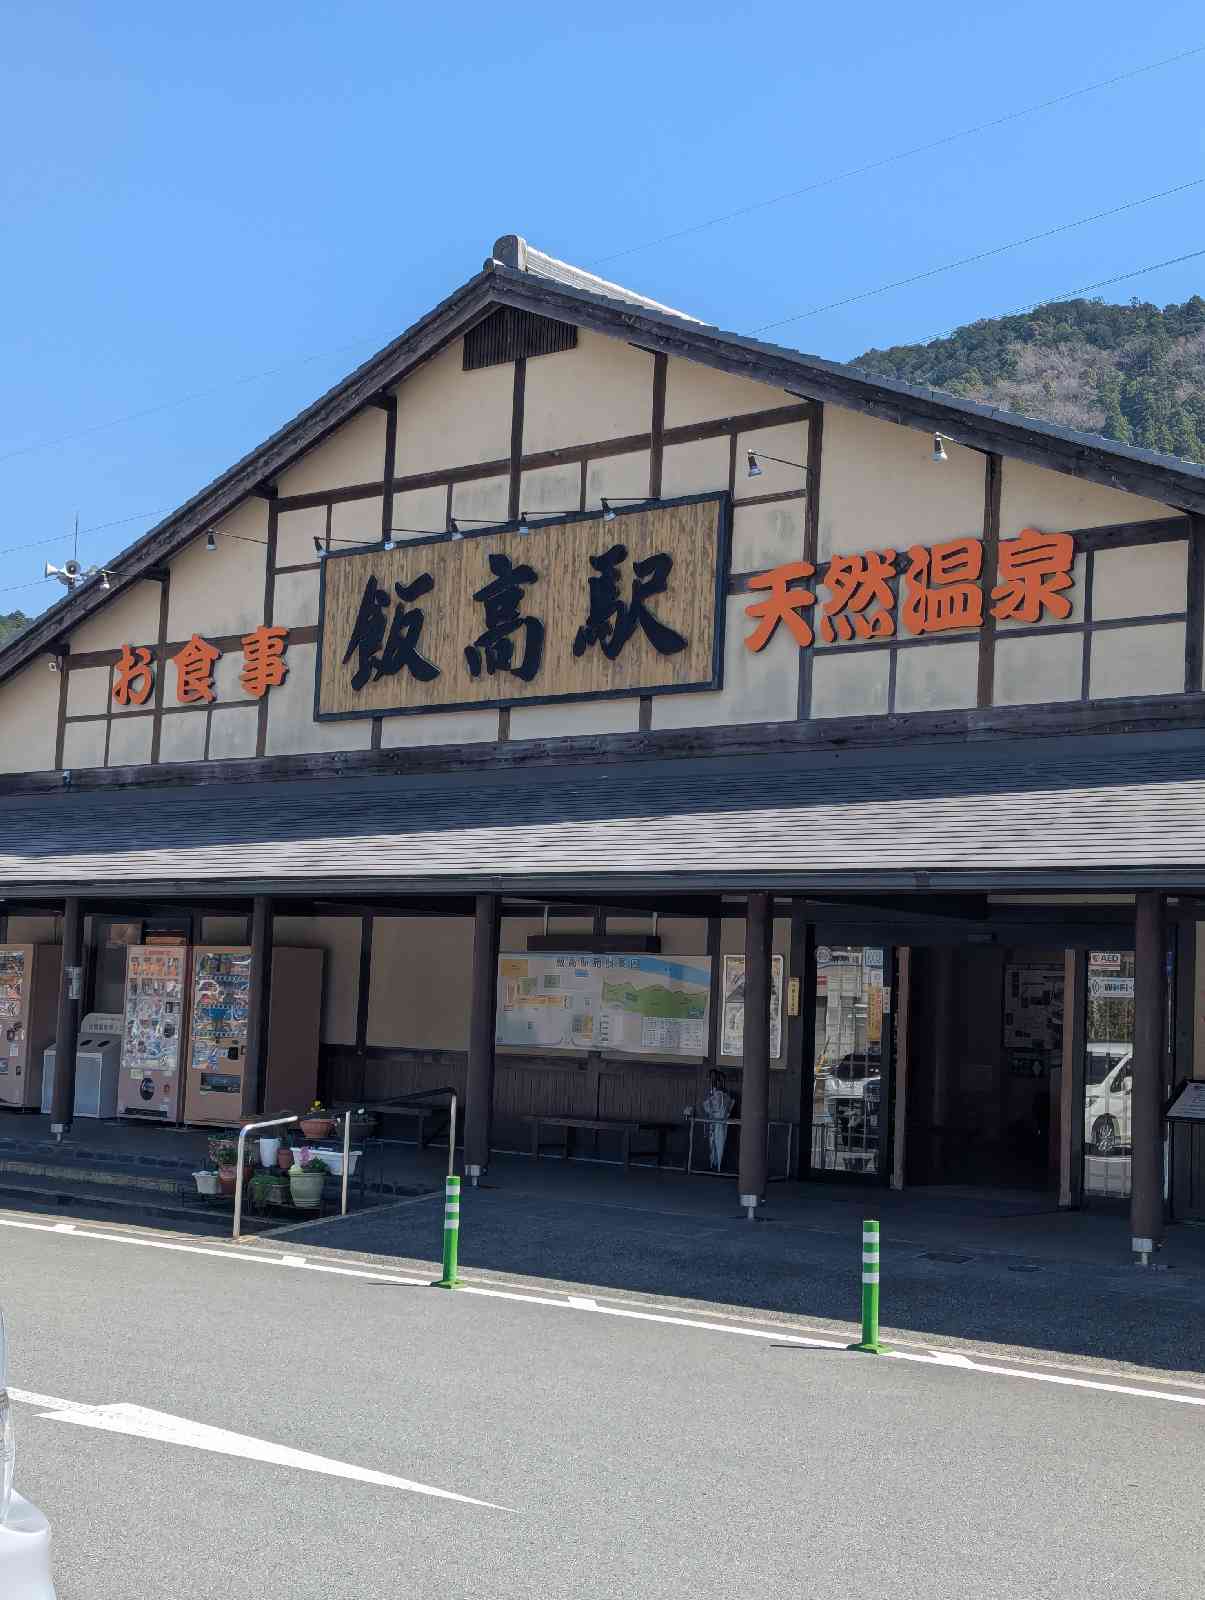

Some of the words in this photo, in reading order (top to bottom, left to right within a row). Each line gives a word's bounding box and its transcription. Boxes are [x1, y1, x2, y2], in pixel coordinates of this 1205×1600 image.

[343, 544, 687, 692] 飯高駅
[745, 529, 1074, 652] 天然温泉
[112, 625, 288, 706] お食事
